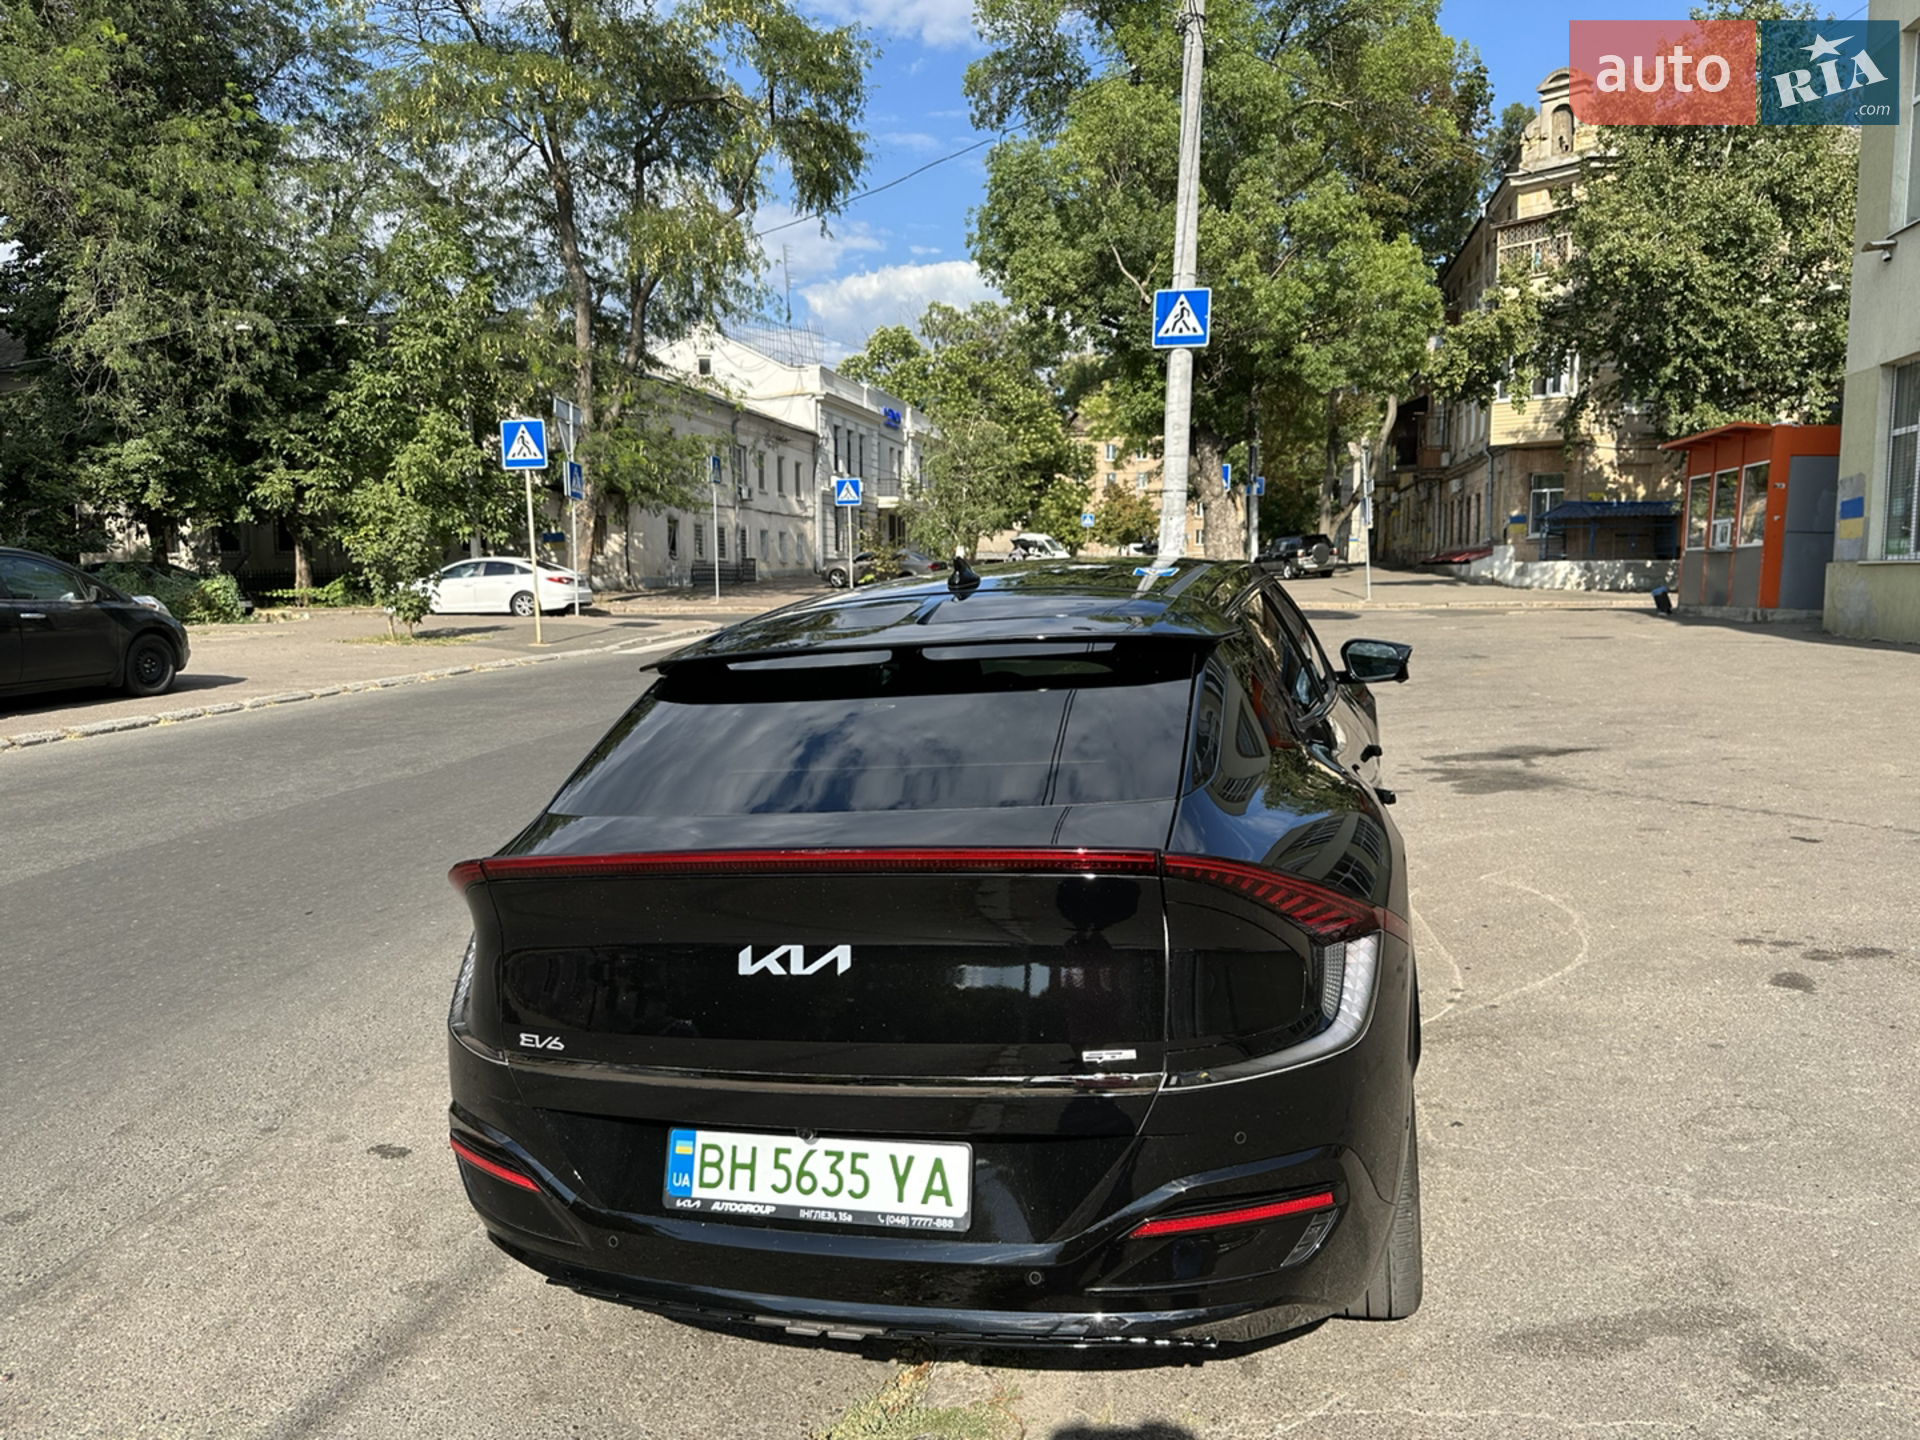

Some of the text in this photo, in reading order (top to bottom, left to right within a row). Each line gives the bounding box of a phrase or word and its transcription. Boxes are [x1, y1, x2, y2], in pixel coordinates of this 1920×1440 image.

[738, 944, 851, 976] KIA
[519, 1032, 565, 1051] EV6
[673, 1172, 691, 1187] UA
[698, 1143, 953, 1207] BH 5635 YA
[675, 1198, 776, 1215] KIA AUTOGROUP
